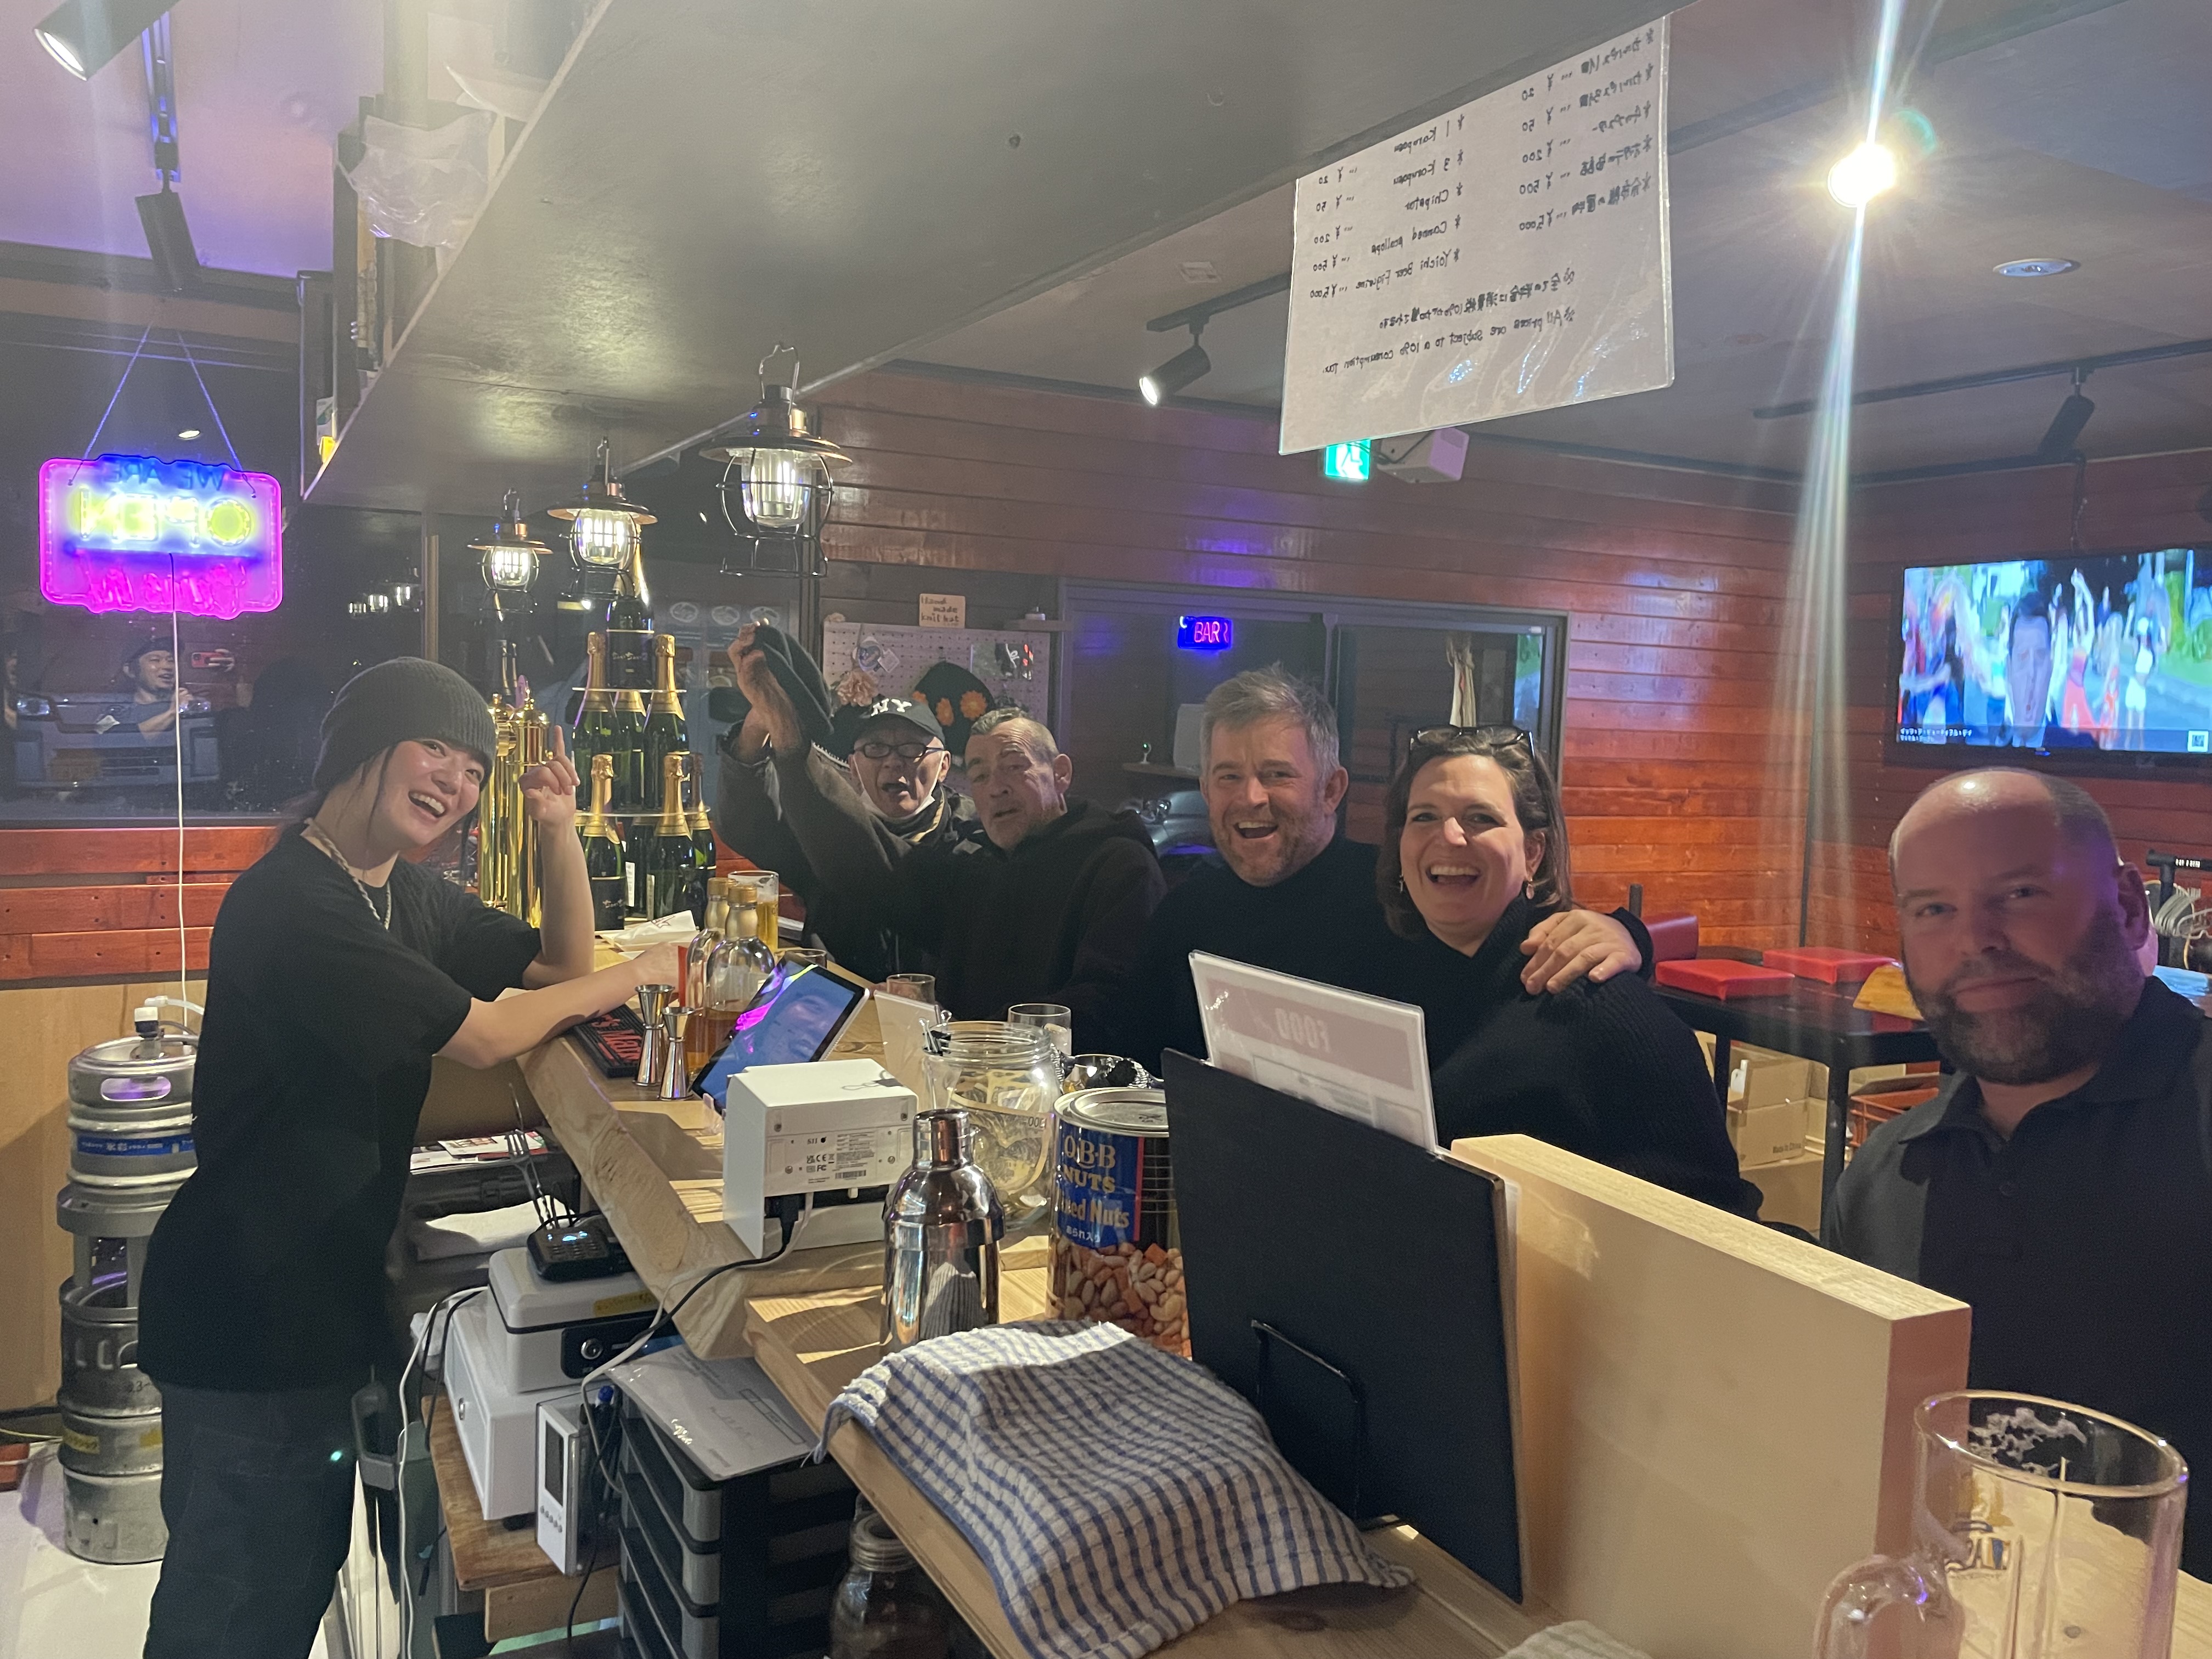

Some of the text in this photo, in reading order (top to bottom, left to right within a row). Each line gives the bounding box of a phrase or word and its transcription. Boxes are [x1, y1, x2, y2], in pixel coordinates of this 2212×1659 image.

[1194, 620, 1220, 643] BAR
[871, 698, 912, 716] NY
[1063, 1164, 1116, 1194] NUTS
[1090, 1198, 1130, 1228] Nuts
